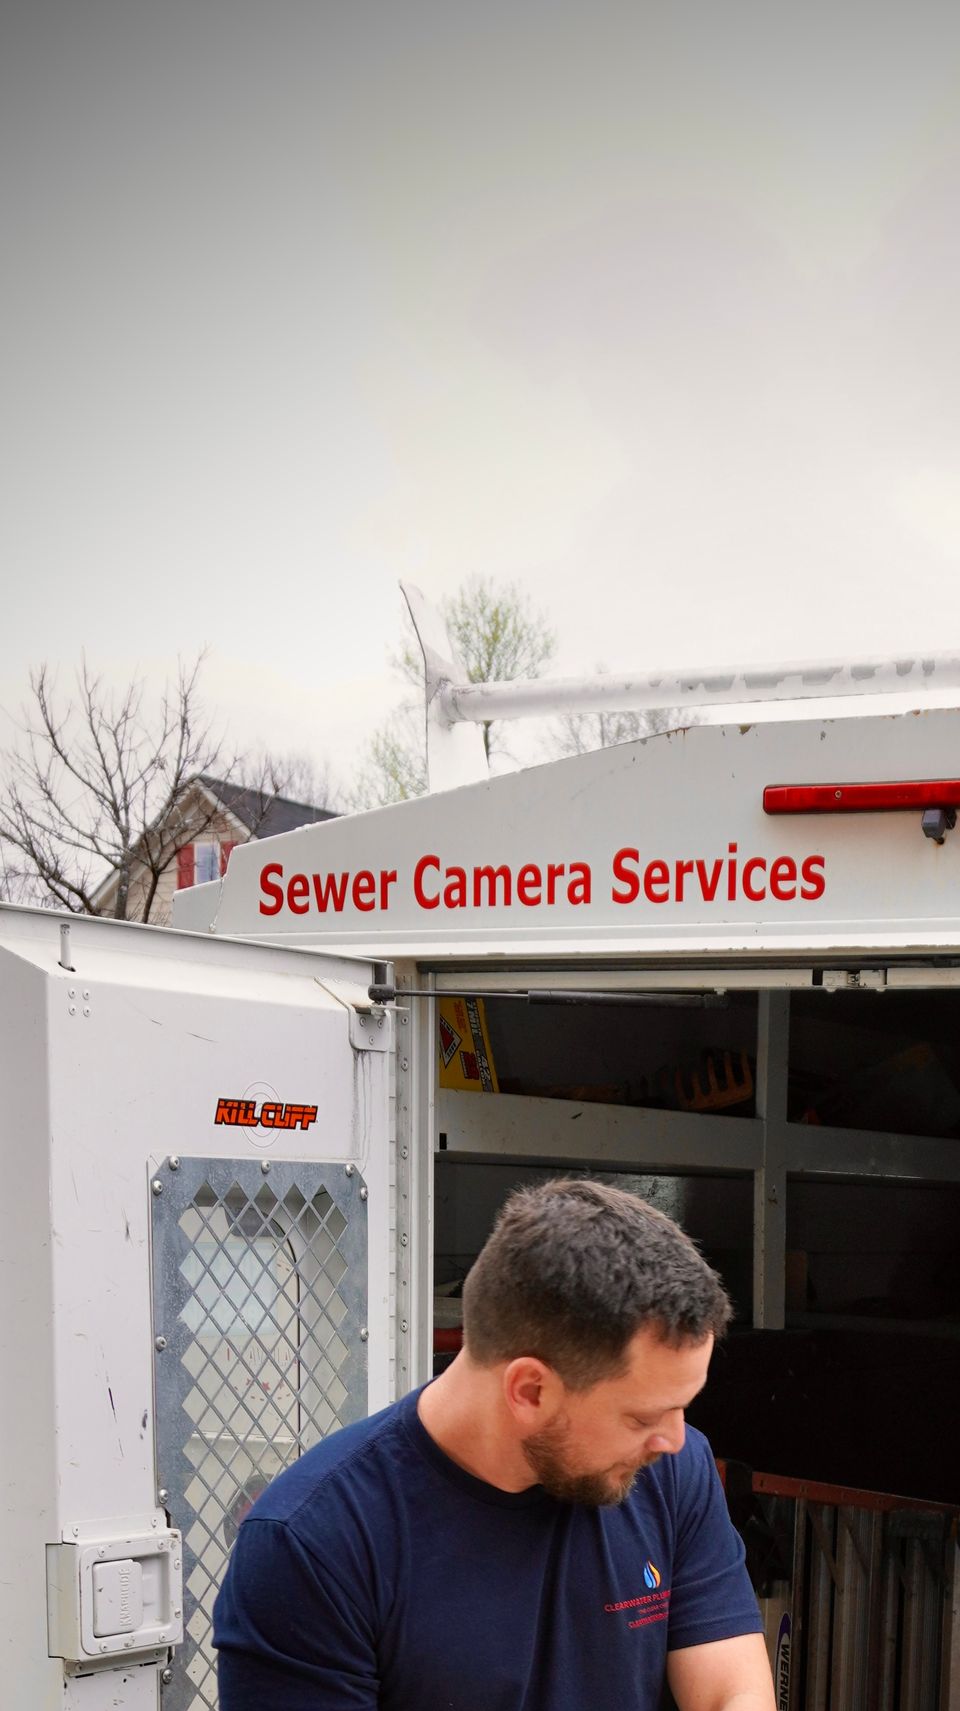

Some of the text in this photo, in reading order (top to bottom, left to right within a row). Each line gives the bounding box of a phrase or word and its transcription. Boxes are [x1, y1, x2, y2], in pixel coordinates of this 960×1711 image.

[257, 841, 827, 917] Sewer Camera Services
[214, 1098, 318, 1130] KILL CLIFF
[603, 1595, 652, 1612] CLEARWATER
